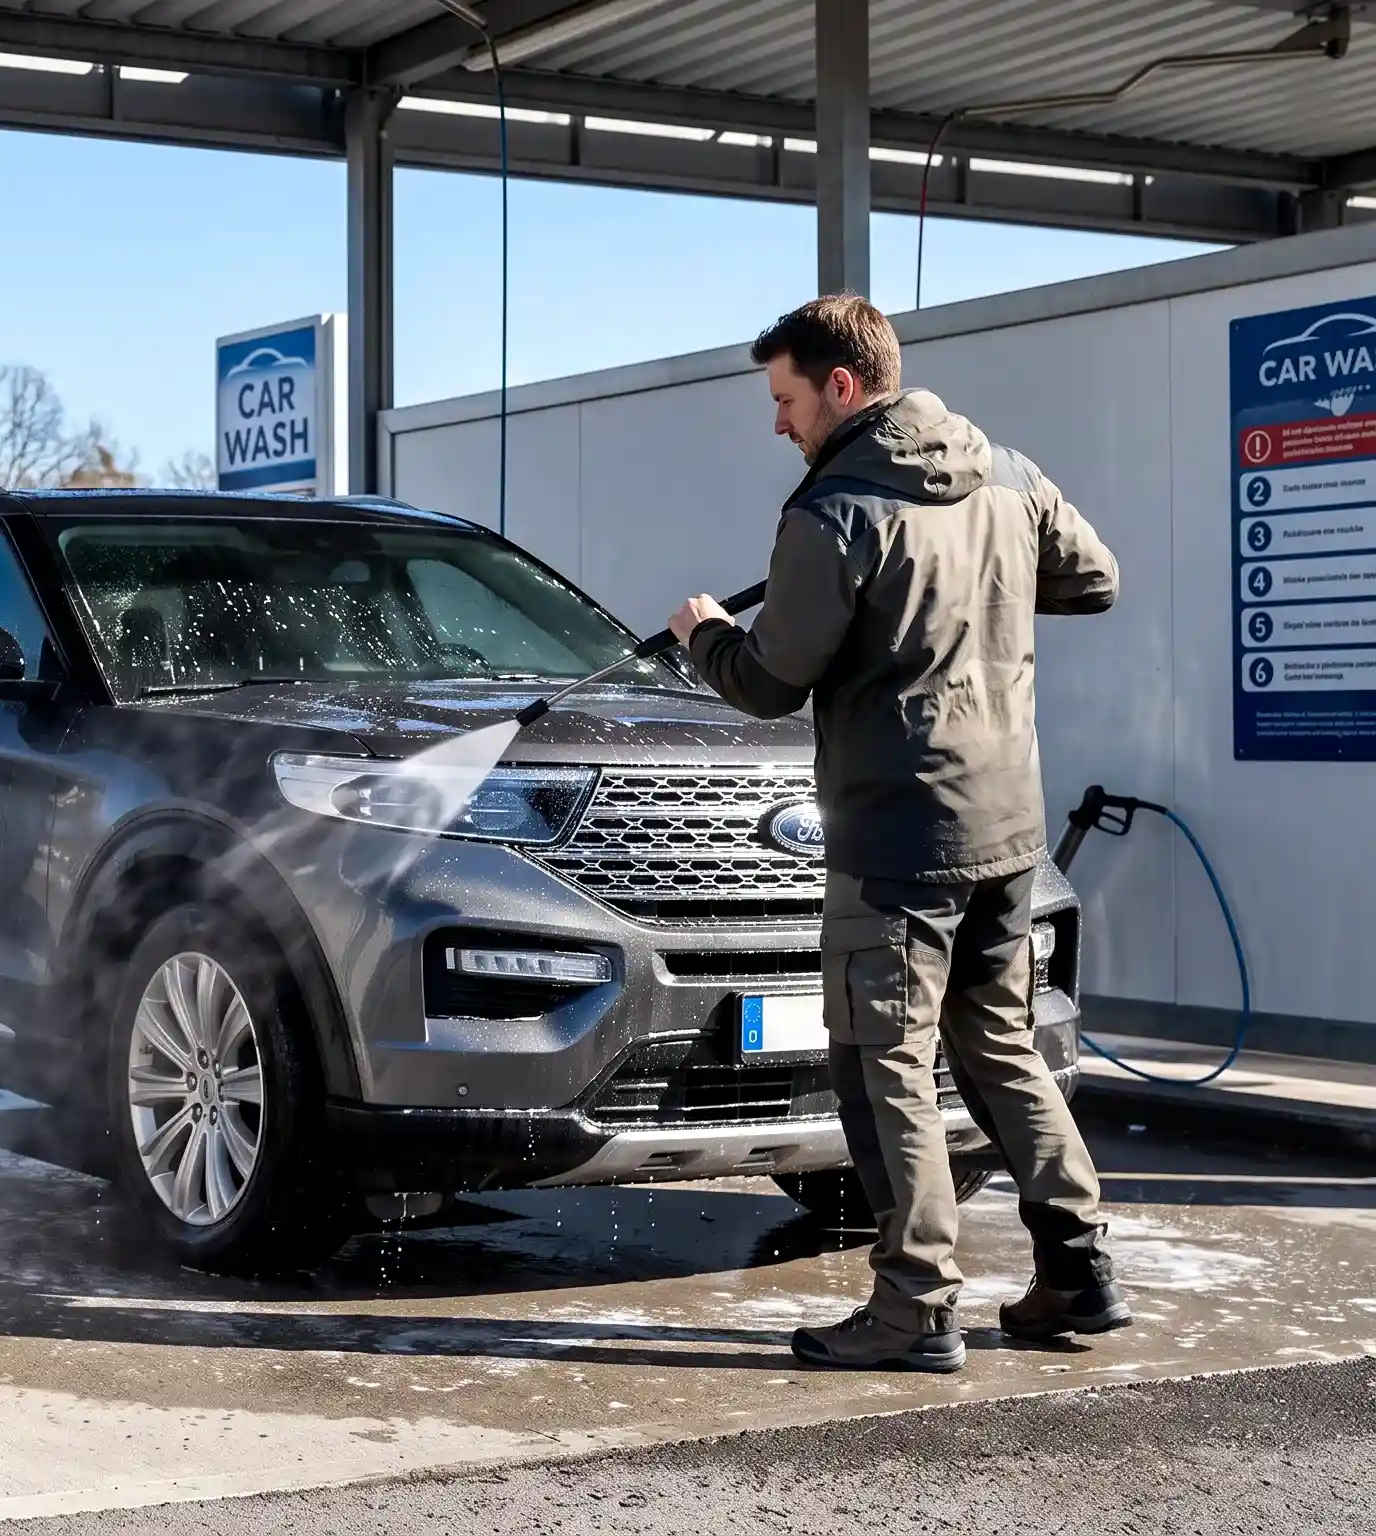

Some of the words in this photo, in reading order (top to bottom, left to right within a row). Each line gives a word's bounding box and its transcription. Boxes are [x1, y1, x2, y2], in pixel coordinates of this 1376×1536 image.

[1258, 356, 1317, 387] CAR
[1324, 346, 1376, 378] WA
[238, 376, 295, 419] CAR
[224, 417, 308, 465] WASH
[1253, 481, 1265, 501] 2
[1254, 527, 1265, 547] 3
[1253, 572, 1265, 591] 4
[1255, 618, 1266, 637] 5
[1255, 662, 1266, 682] 6
[797, 817, 825, 841] Fo
